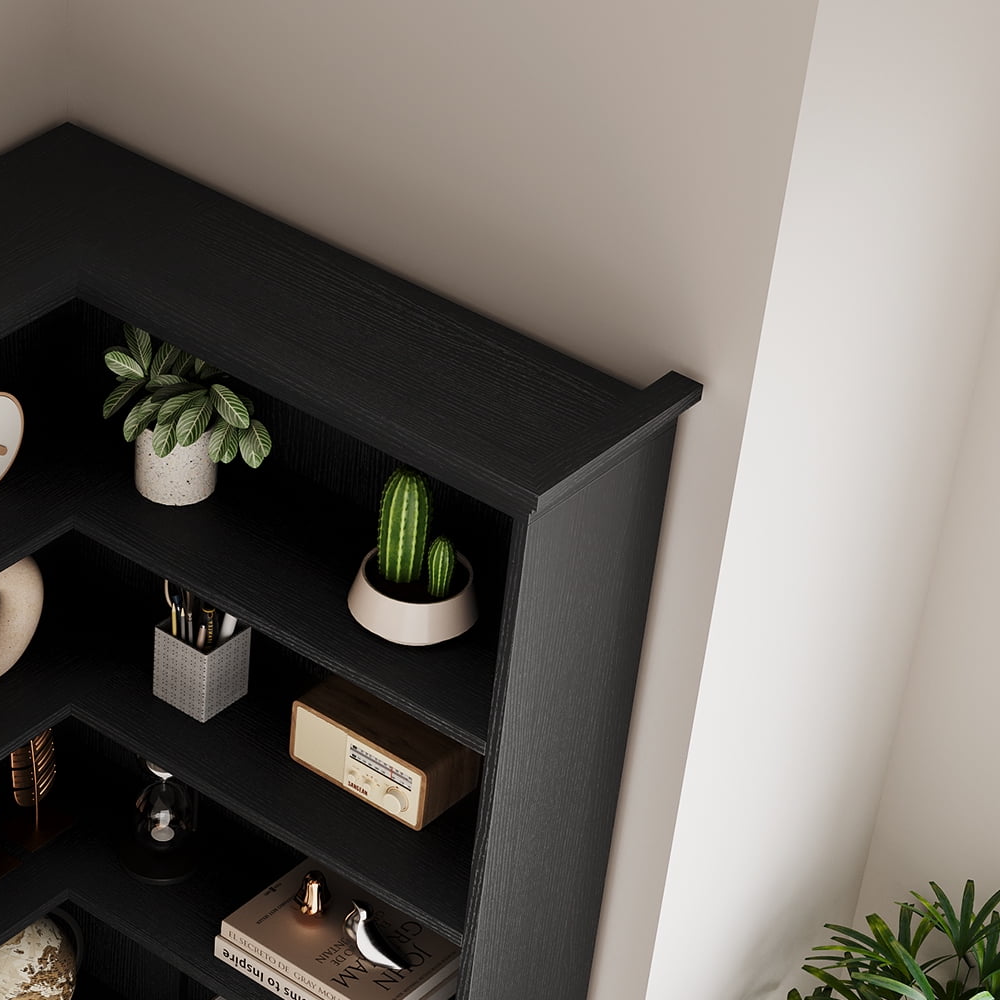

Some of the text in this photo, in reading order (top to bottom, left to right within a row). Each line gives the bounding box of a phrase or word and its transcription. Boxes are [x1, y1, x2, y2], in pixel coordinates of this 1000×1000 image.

[222, 948, 264, 981] Inspire
[228, 930, 239, 941] EL
[239, 937, 277, 963] SECRETO
[278, 960, 290, 974] DE
[293, 969, 317, 990] GRAY
[331, 921, 423, 988] GRAM
[267, 976, 280, 992] to
